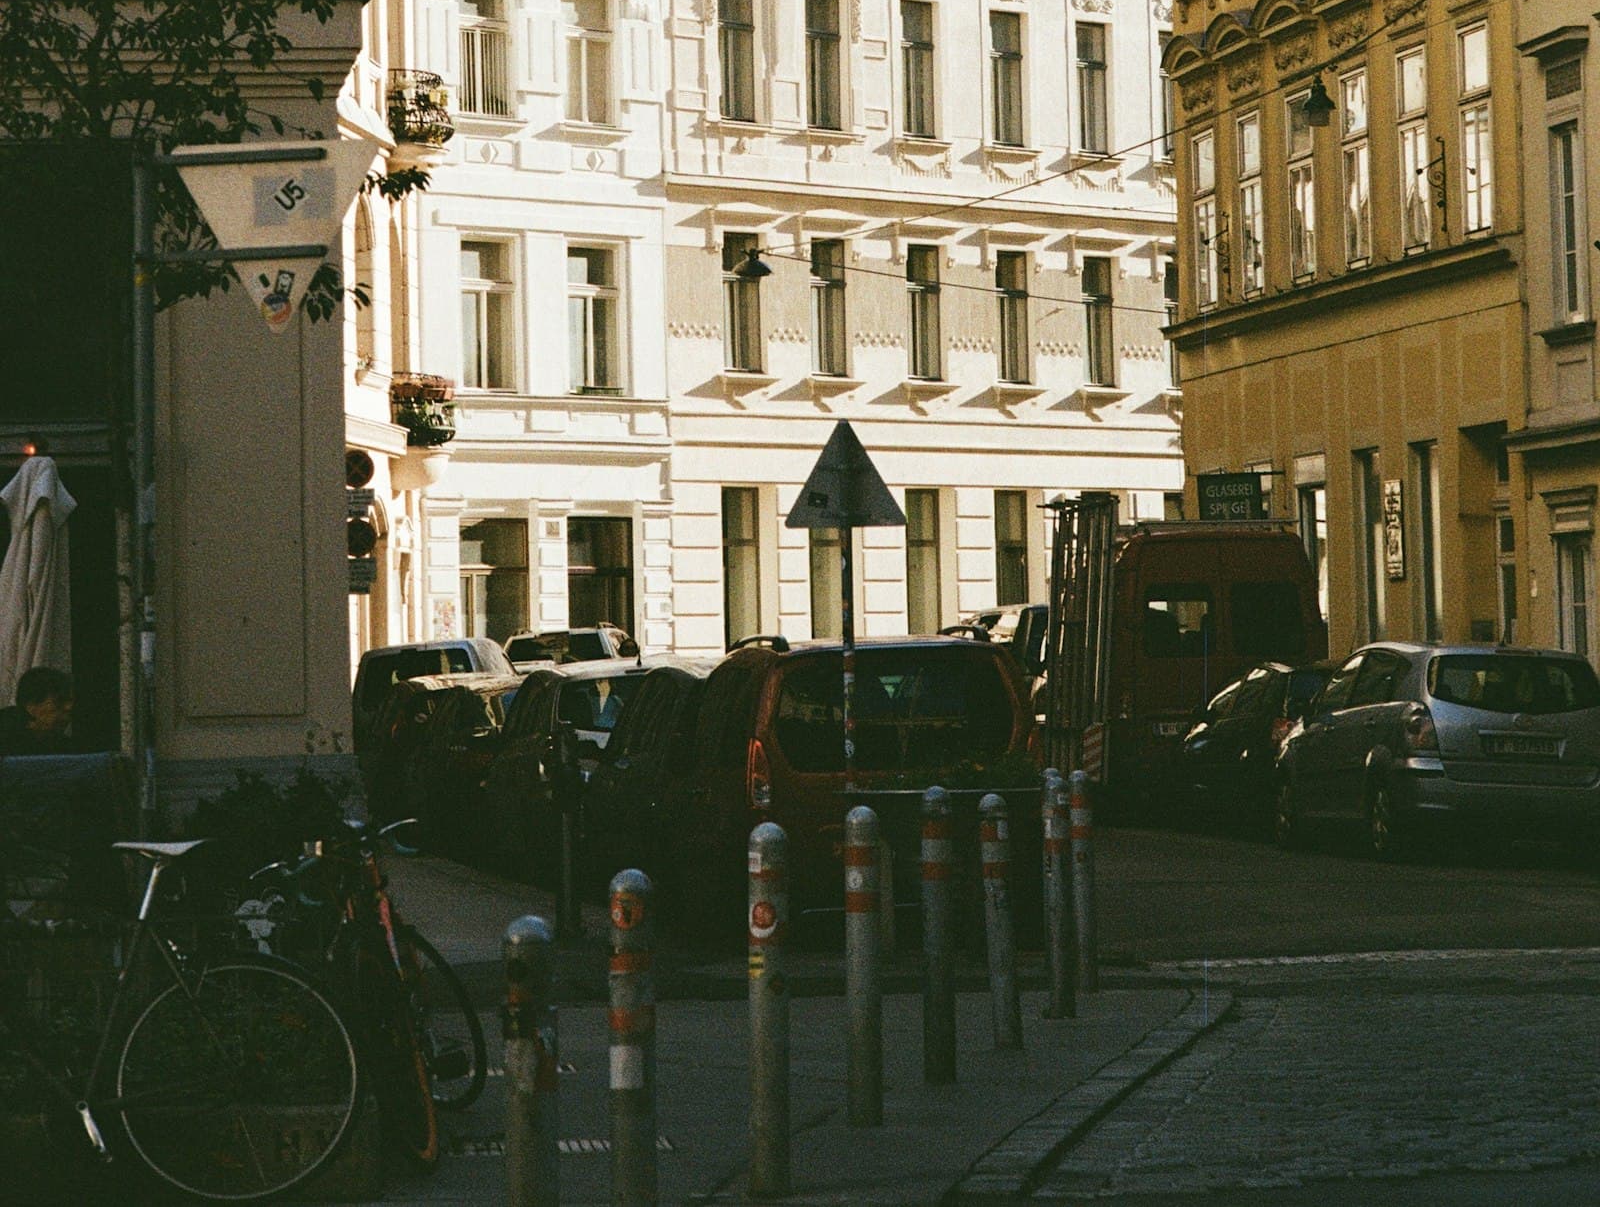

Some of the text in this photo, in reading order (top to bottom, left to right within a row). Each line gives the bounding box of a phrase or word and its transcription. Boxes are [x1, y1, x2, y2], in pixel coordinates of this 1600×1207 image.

[273, 178, 306, 211] U5
[1206, 482, 1253, 498] GLASEREI
[1209, 500, 1251, 515] SPIGEL
